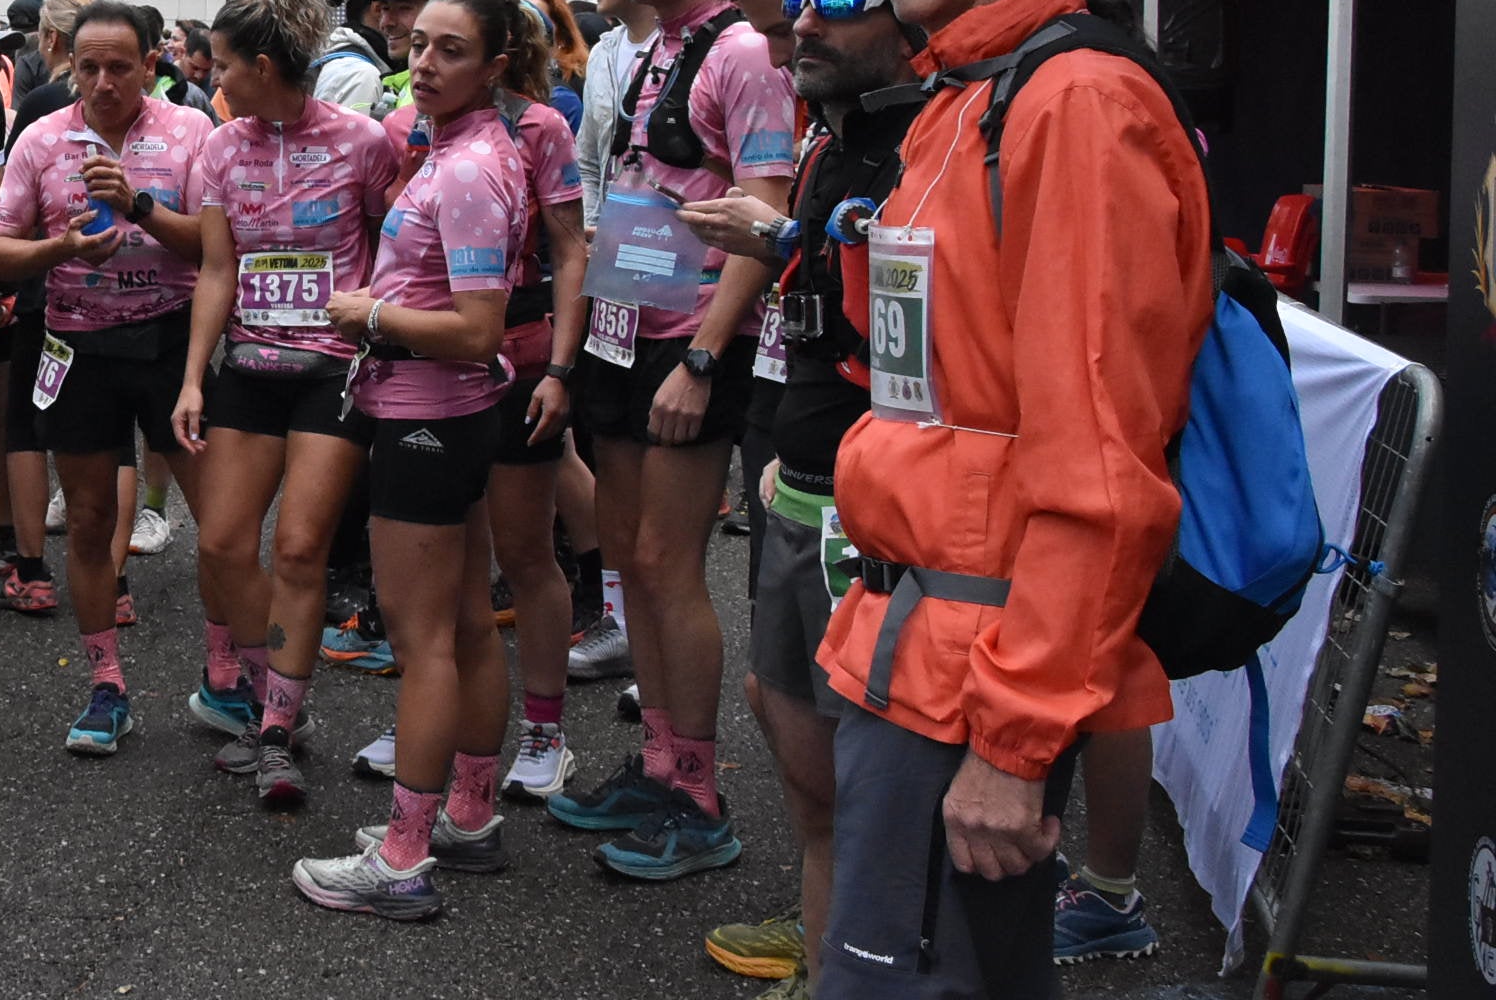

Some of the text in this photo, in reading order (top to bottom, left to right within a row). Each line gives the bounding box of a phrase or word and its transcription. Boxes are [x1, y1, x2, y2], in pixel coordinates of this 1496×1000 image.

[117, 269, 159, 288] MSC
[250, 274, 319, 302] 1375
[594, 300, 629, 340] 1358
[873, 297, 906, 358] 69
[388, 875, 425, 896] HOKA
